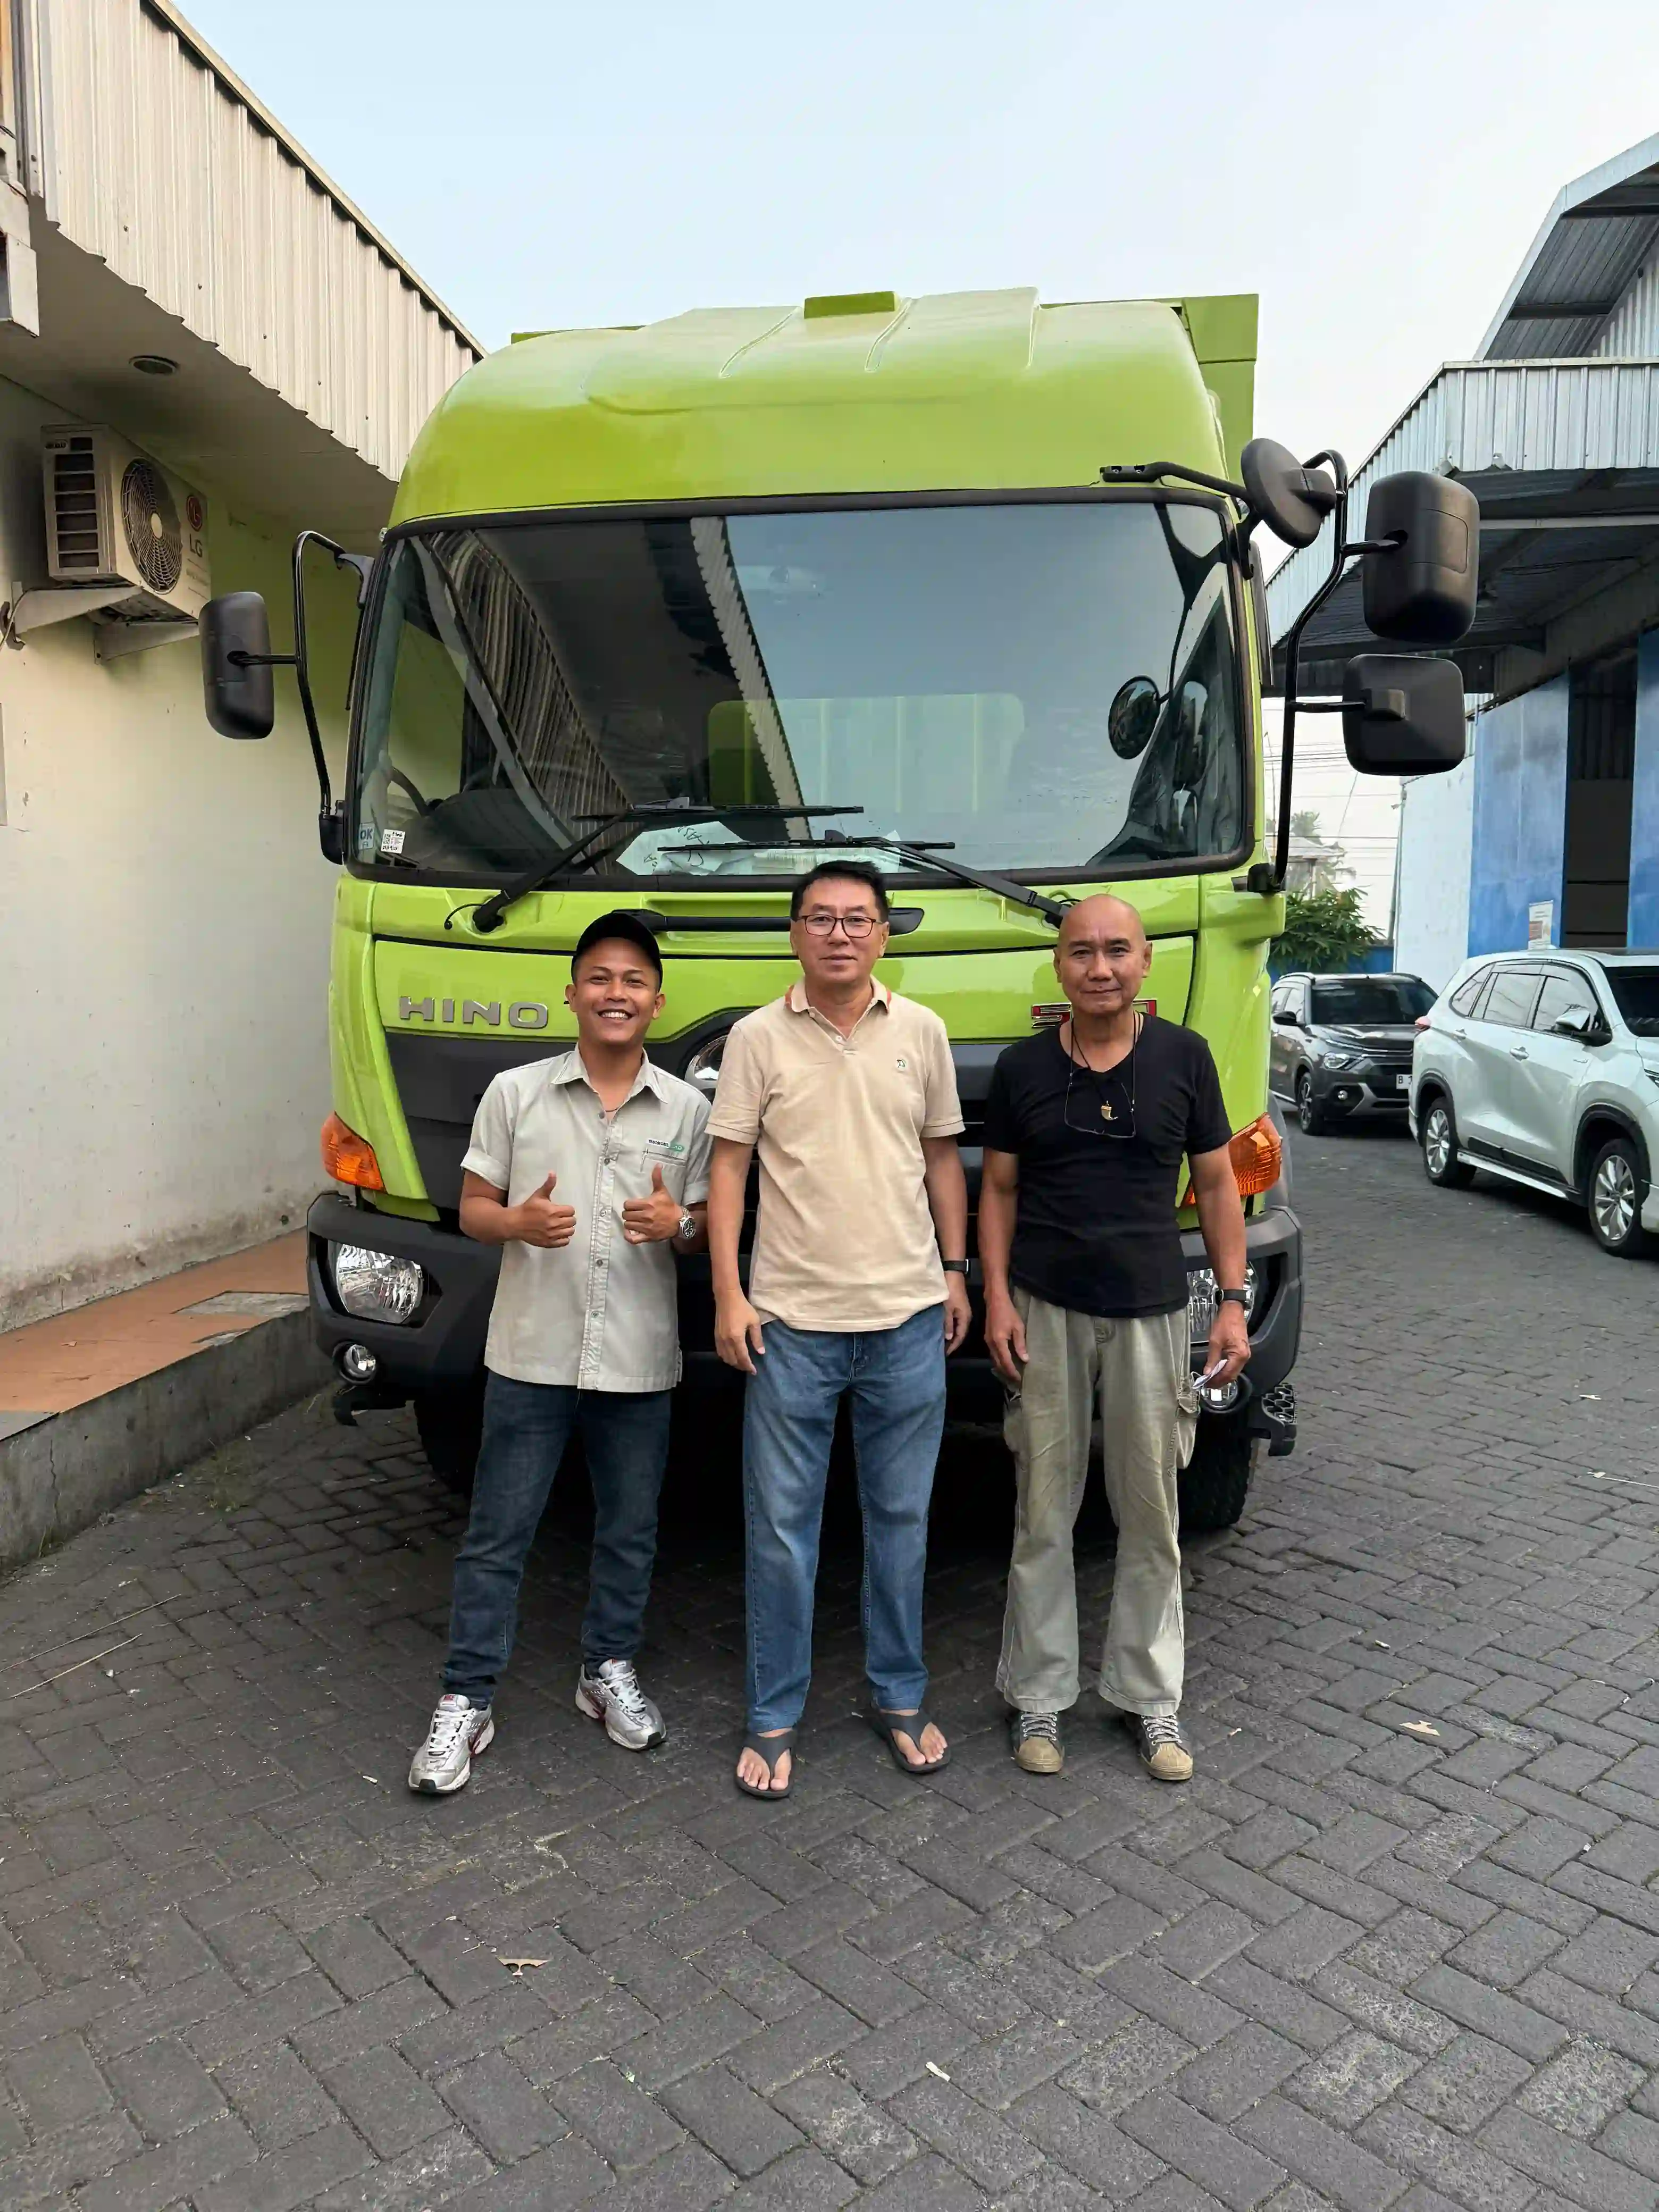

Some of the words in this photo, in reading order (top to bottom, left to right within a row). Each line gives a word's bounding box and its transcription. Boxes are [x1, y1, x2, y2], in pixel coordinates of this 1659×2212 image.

[190, 533, 202, 557] LG
[361, 828, 373, 840] OK
[400, 996, 548, 1029] HINO
